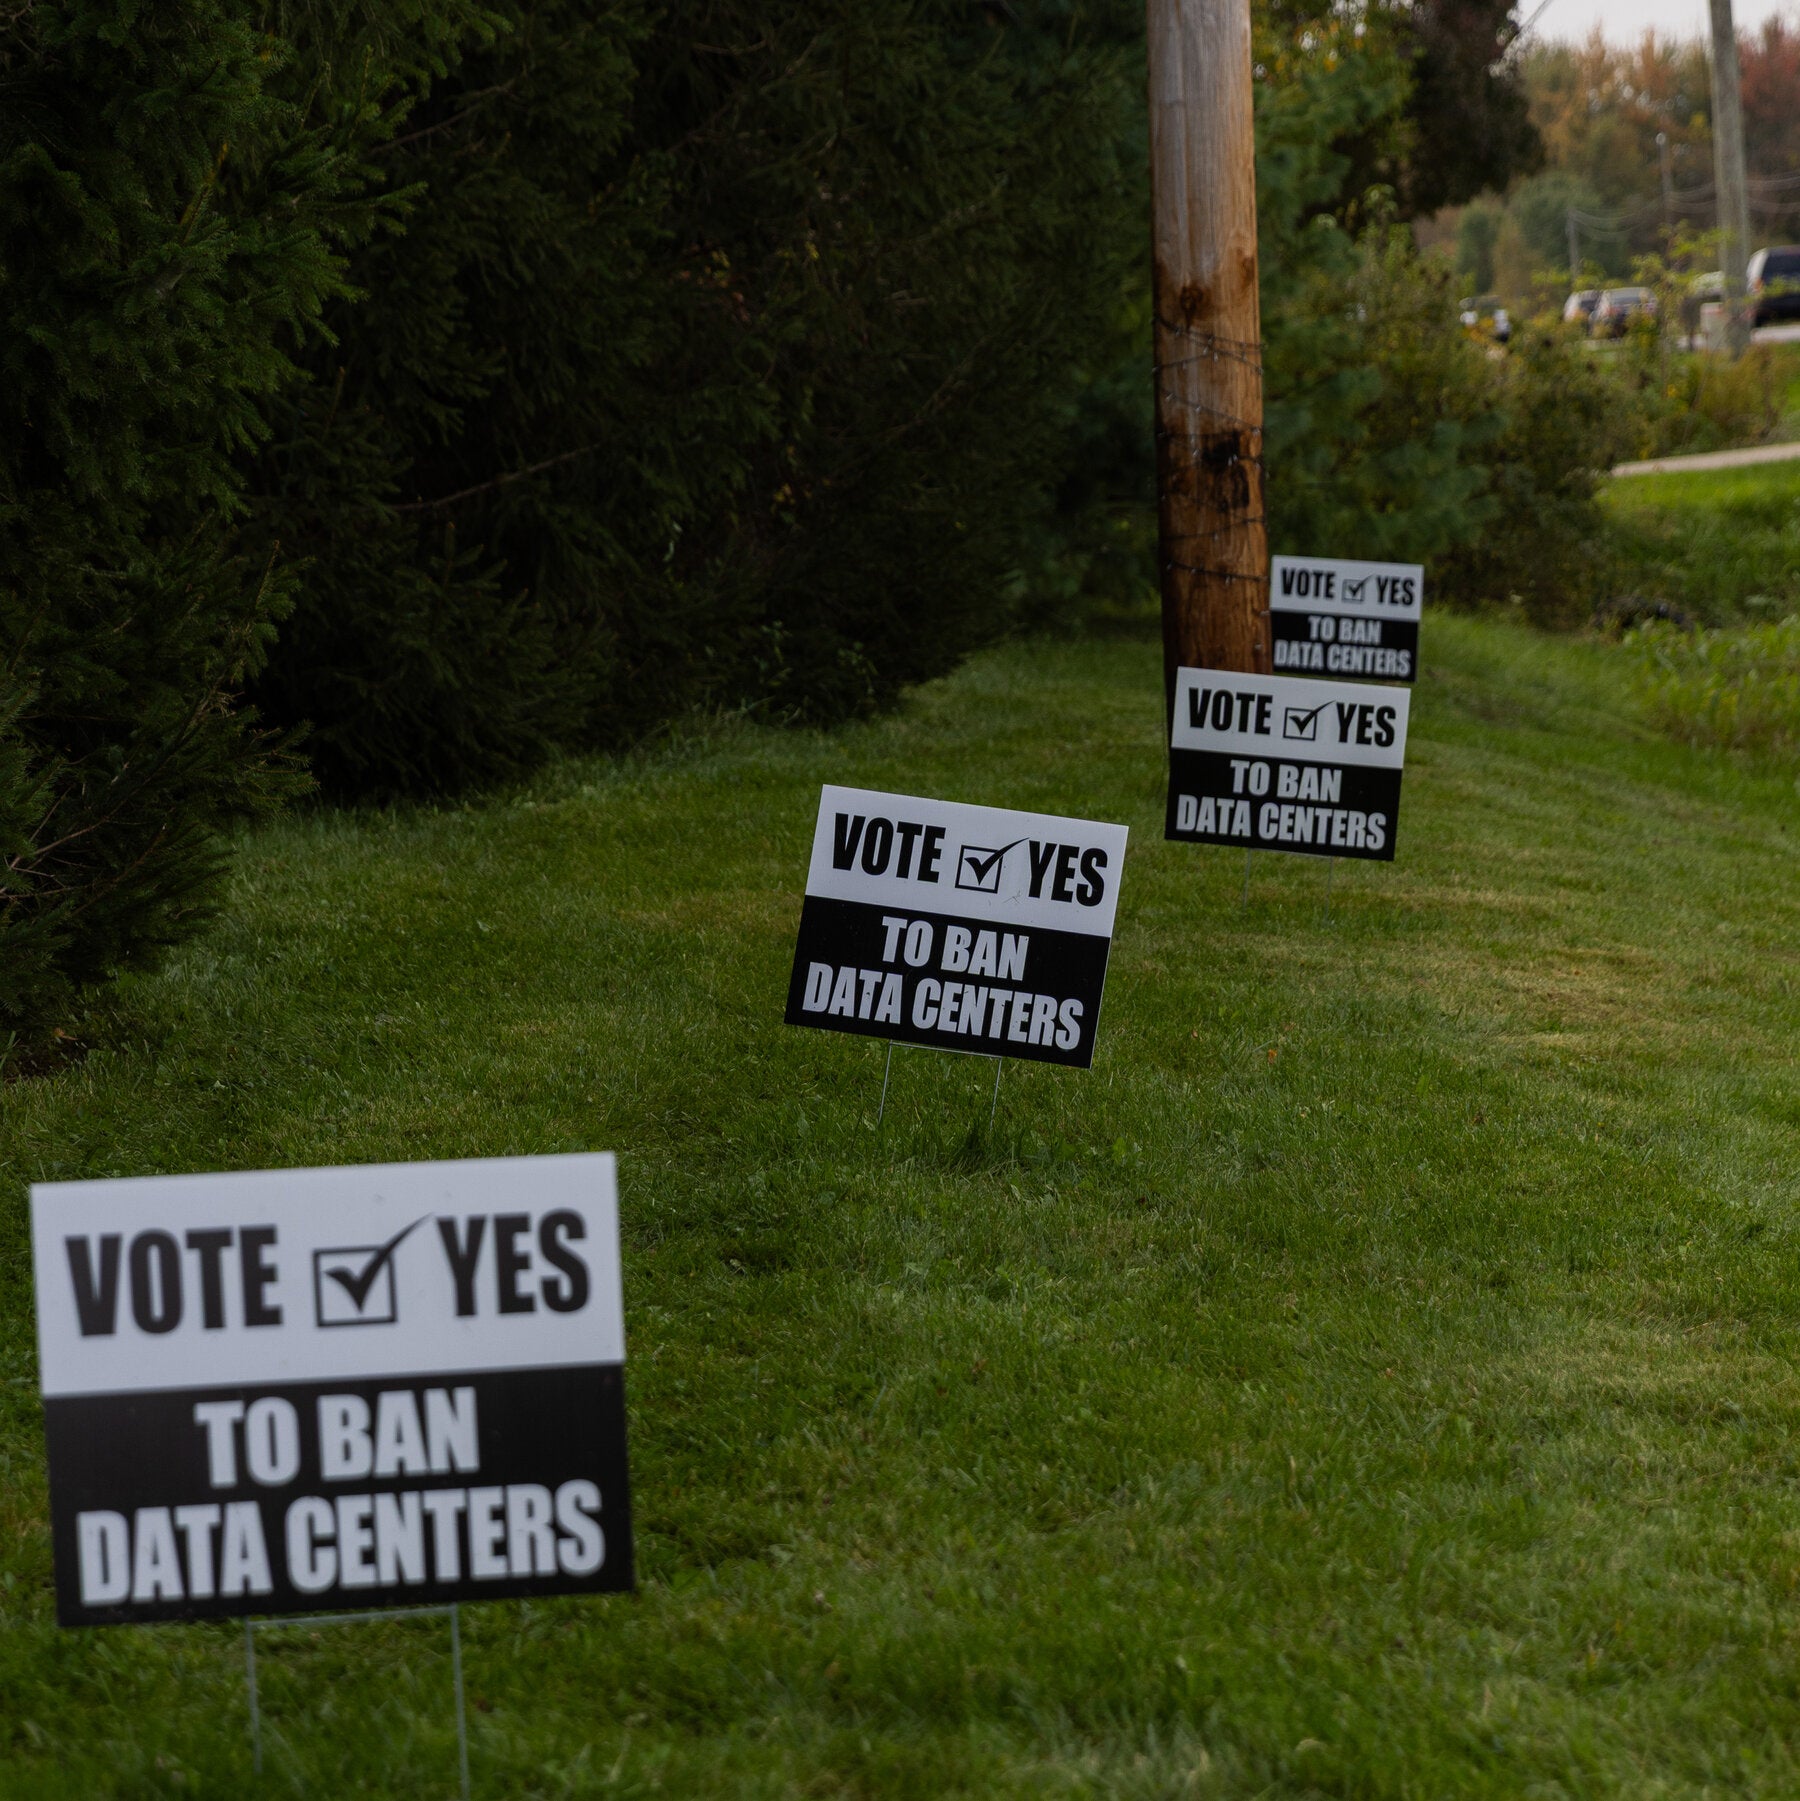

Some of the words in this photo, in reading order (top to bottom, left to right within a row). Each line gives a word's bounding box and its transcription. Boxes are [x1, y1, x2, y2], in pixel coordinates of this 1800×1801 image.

[1281, 567, 1335, 599] VOTE
[1376, 575, 1414, 606] YES
[1274, 640, 1325, 668] DATA
[1327, 643, 1411, 677] CENTERS
[1308, 615, 1335, 640] TO
[1339, 618, 1382, 644] BAN
[1189, 687, 1273, 735] VOTE
[1336, 703, 1396, 747] YES
[1230, 760, 1270, 797] TO
[1277, 764, 1342, 803] BAN
[1176, 794, 1251, 837] DATA
[1258, 802, 1387, 850] CENTERS
[832, 813, 945, 883] VOTE
[1028, 841, 1108, 907] YES
[882, 916, 934, 967] TO
[940, 925, 1029, 981] BAN
[802, 962, 903, 1025] DATA
[912, 978, 1084, 1050] CENTERS
[64, 1224, 283, 1337] VOTE
[437, 1208, 590, 1317] YES
[193, 1397, 301, 1489] TO
[317, 1386, 480, 1482] BAN
[77, 1500, 273, 1607] DATA
[285, 1479, 606, 1592] CENTERS
